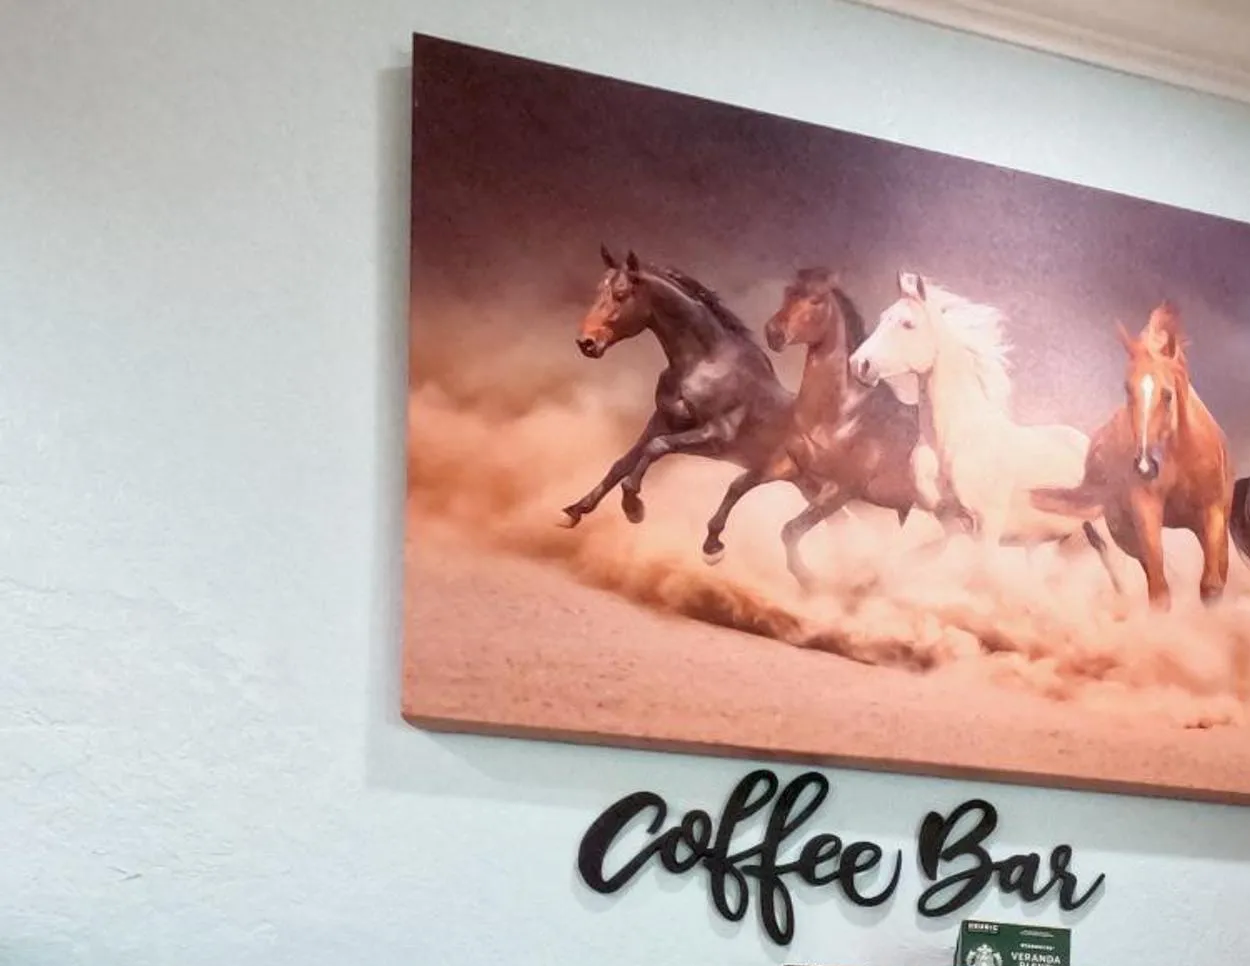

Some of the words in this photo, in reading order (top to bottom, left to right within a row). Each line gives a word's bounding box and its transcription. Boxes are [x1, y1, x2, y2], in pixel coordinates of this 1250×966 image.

[578, 769, 901, 945] Coffee
[917, 799, 1105, 917] Bar
[1011, 951, 1061, 965] VERANDA
